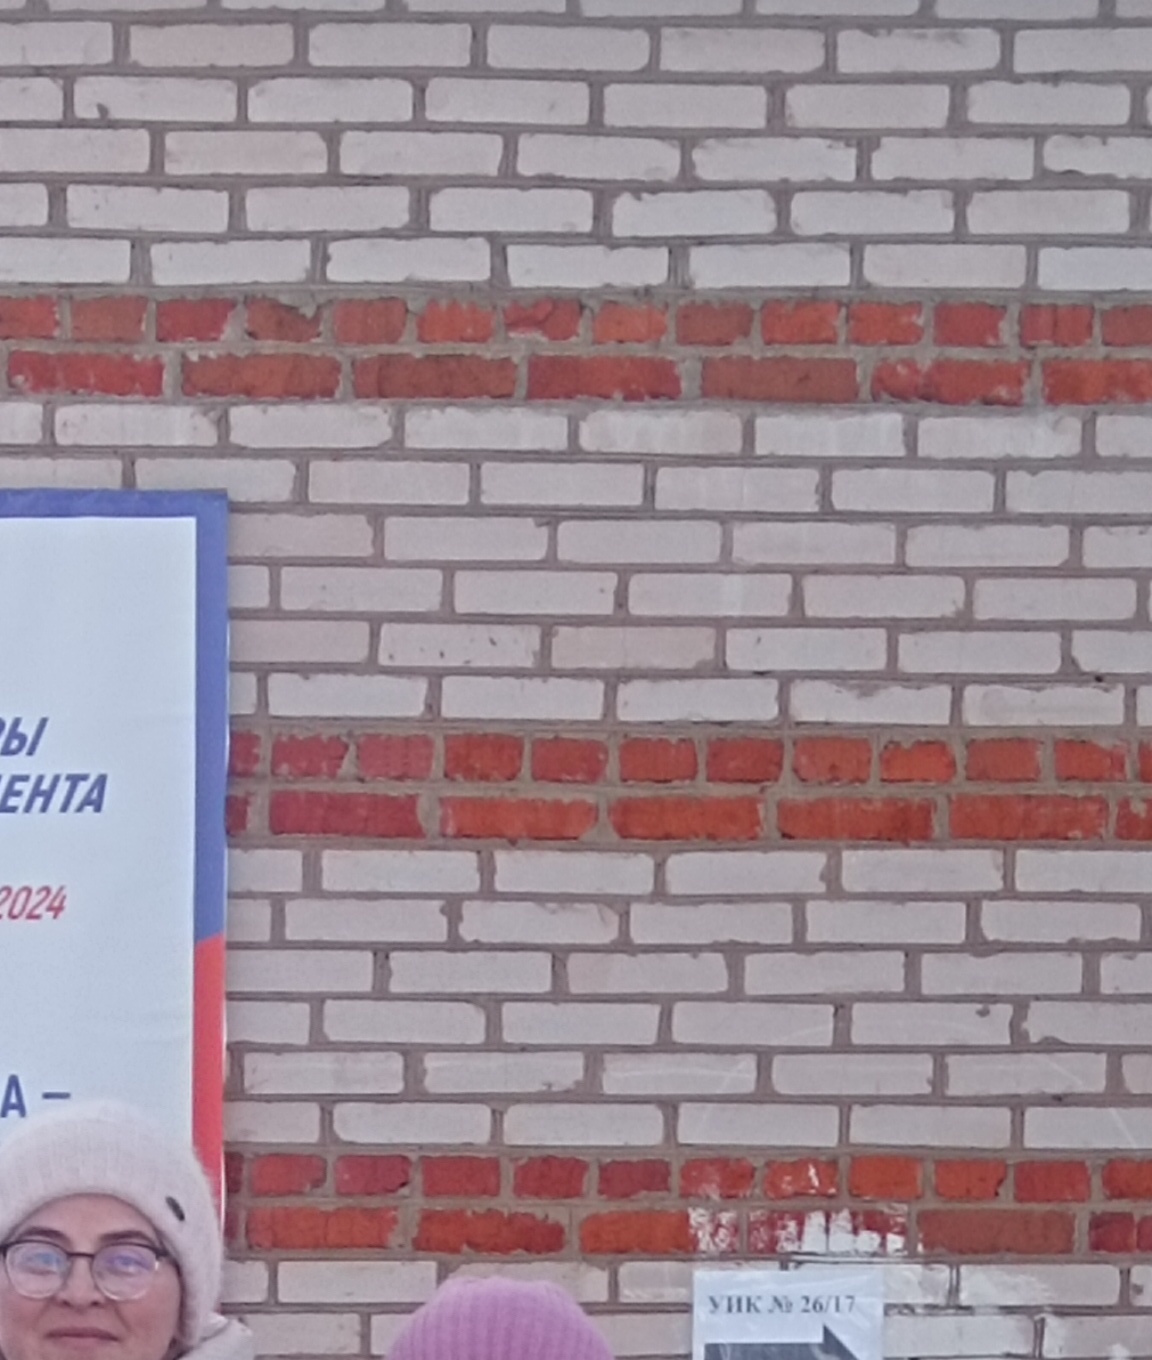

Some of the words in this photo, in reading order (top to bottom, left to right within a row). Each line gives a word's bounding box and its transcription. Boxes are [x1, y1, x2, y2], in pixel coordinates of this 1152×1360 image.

[708, 1295, 763, 1314] УИК
[768, 1295, 794, 1313] №
[800, 1295, 856, 1314] 26/17
